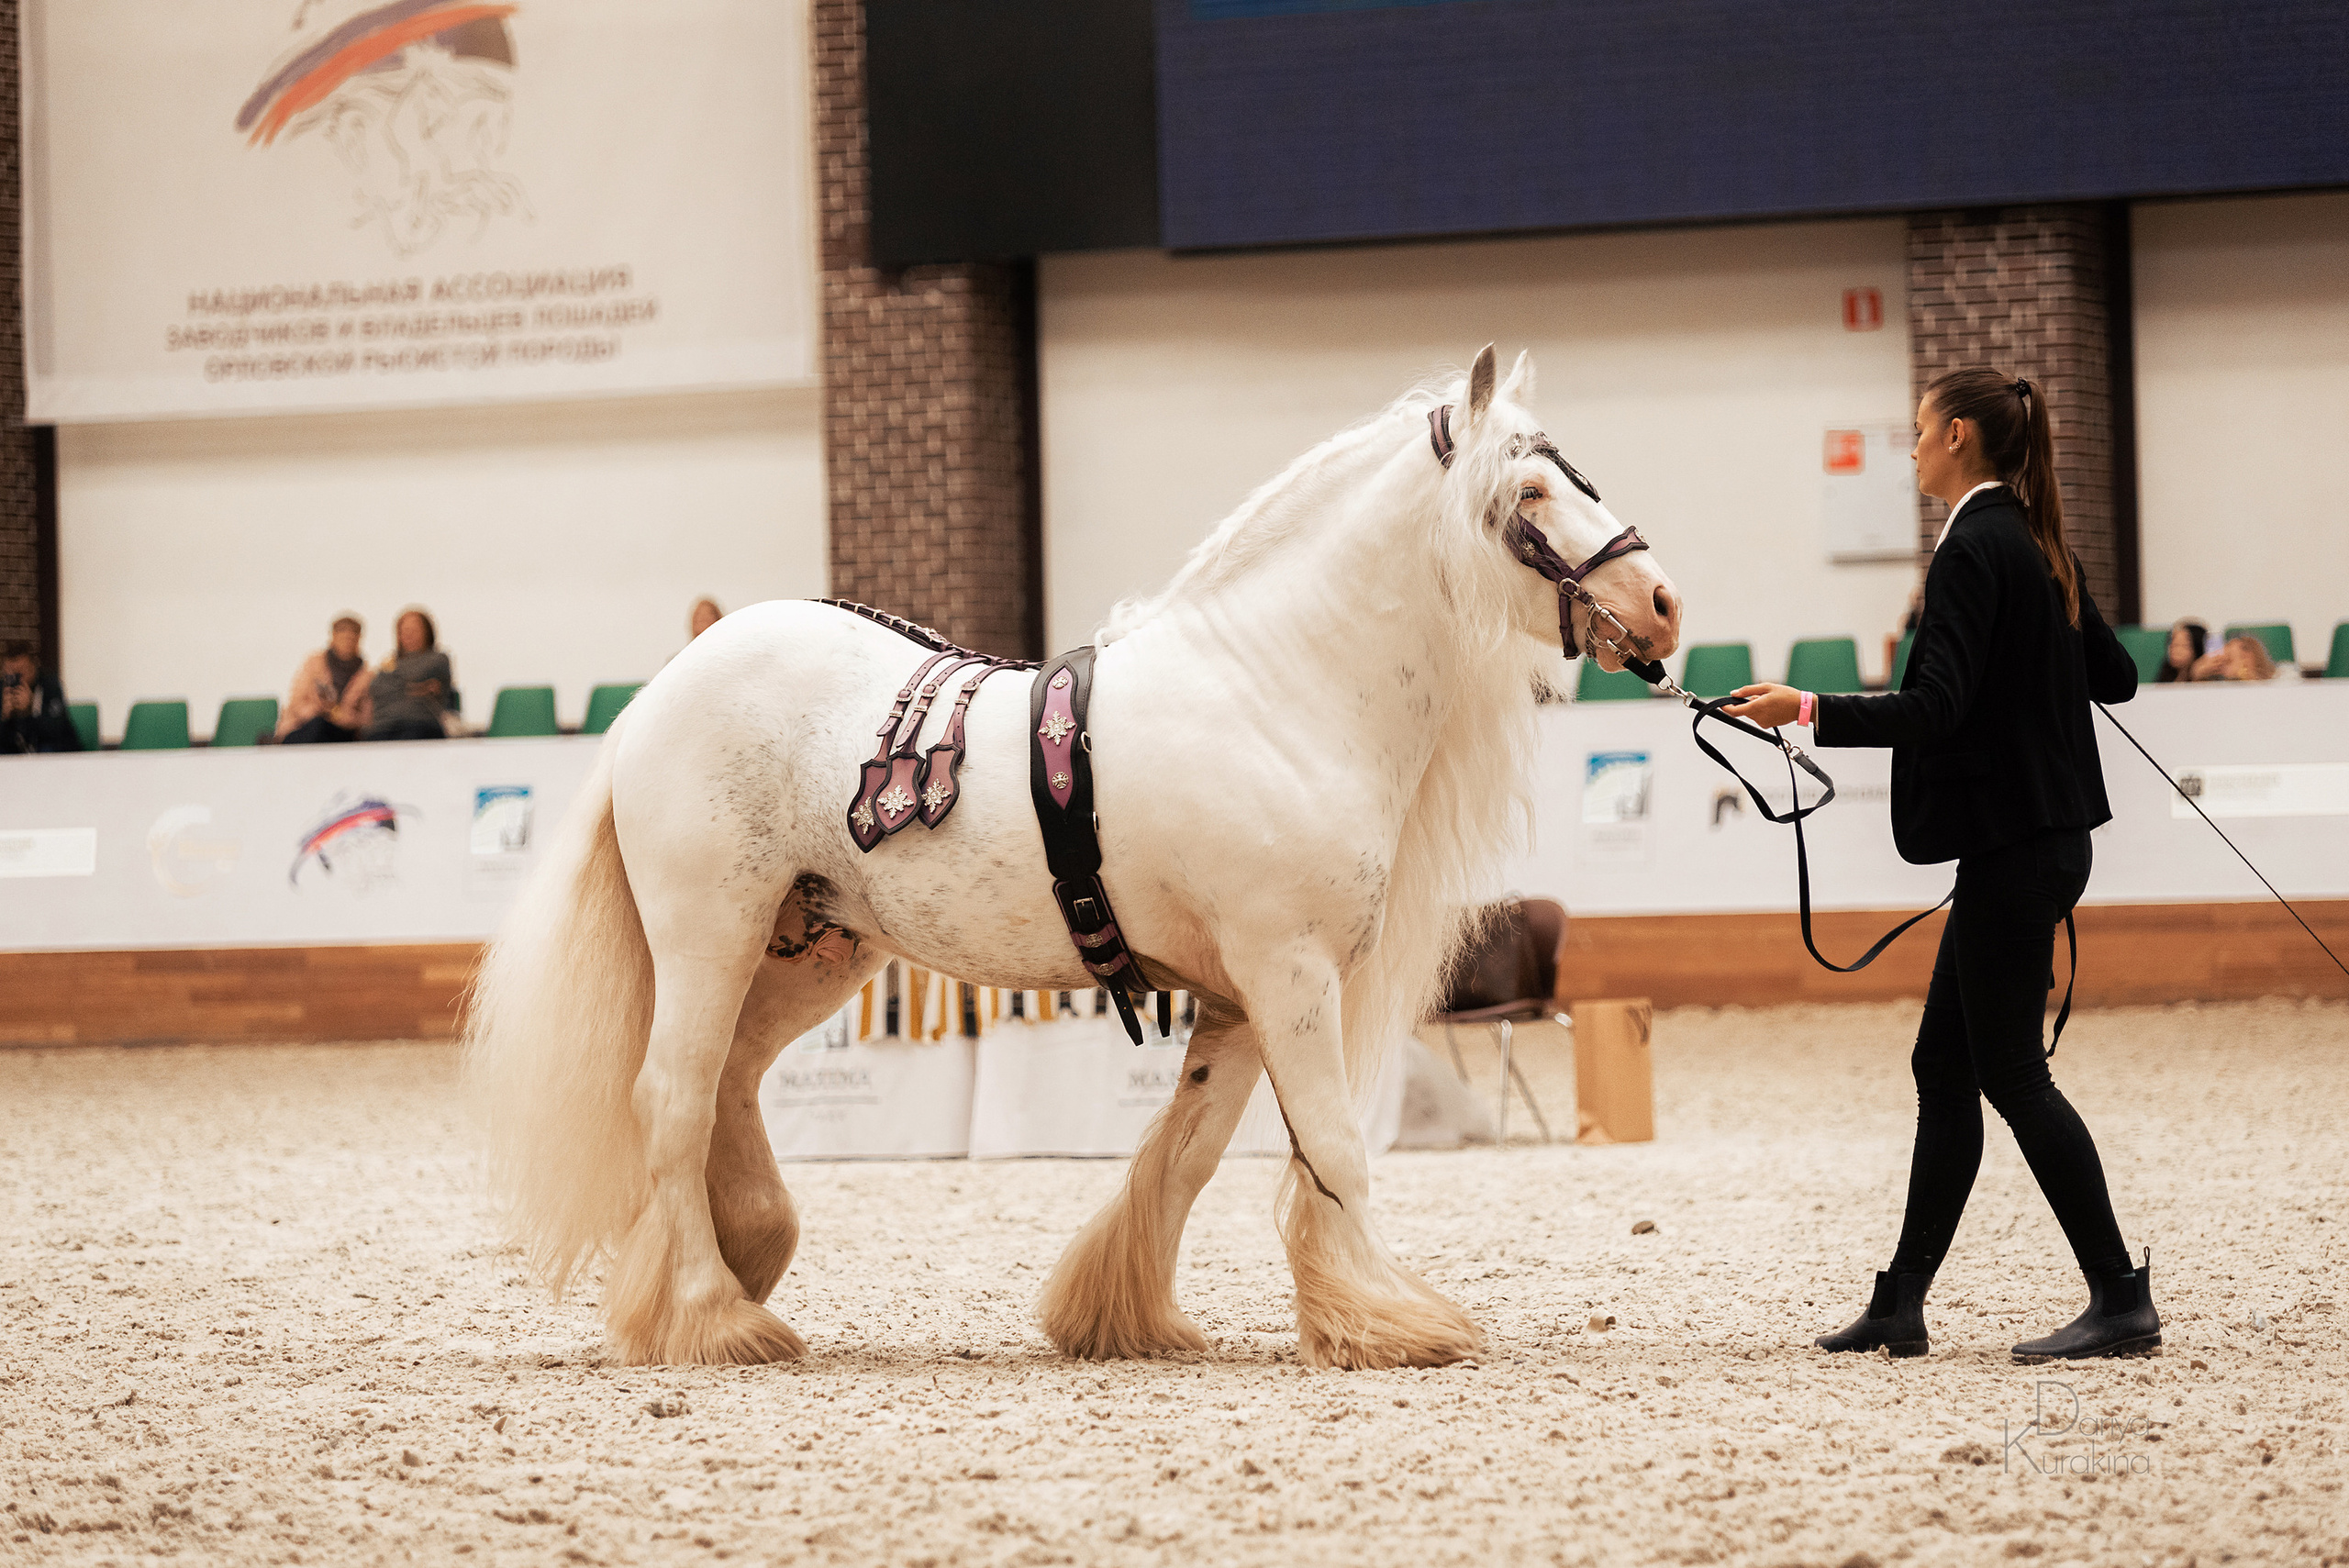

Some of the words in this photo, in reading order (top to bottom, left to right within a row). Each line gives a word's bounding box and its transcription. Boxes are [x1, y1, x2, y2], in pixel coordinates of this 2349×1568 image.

[187, 281, 424, 316] НАЦИОНАЛЬНАЯ
[431, 264, 632, 303] АССОЦИАЦИЯ
[165, 320, 329, 352] ЗАВОДЧИКОВ
[361, 307, 523, 340] ВЛАДЕЛЬЦЕВ
